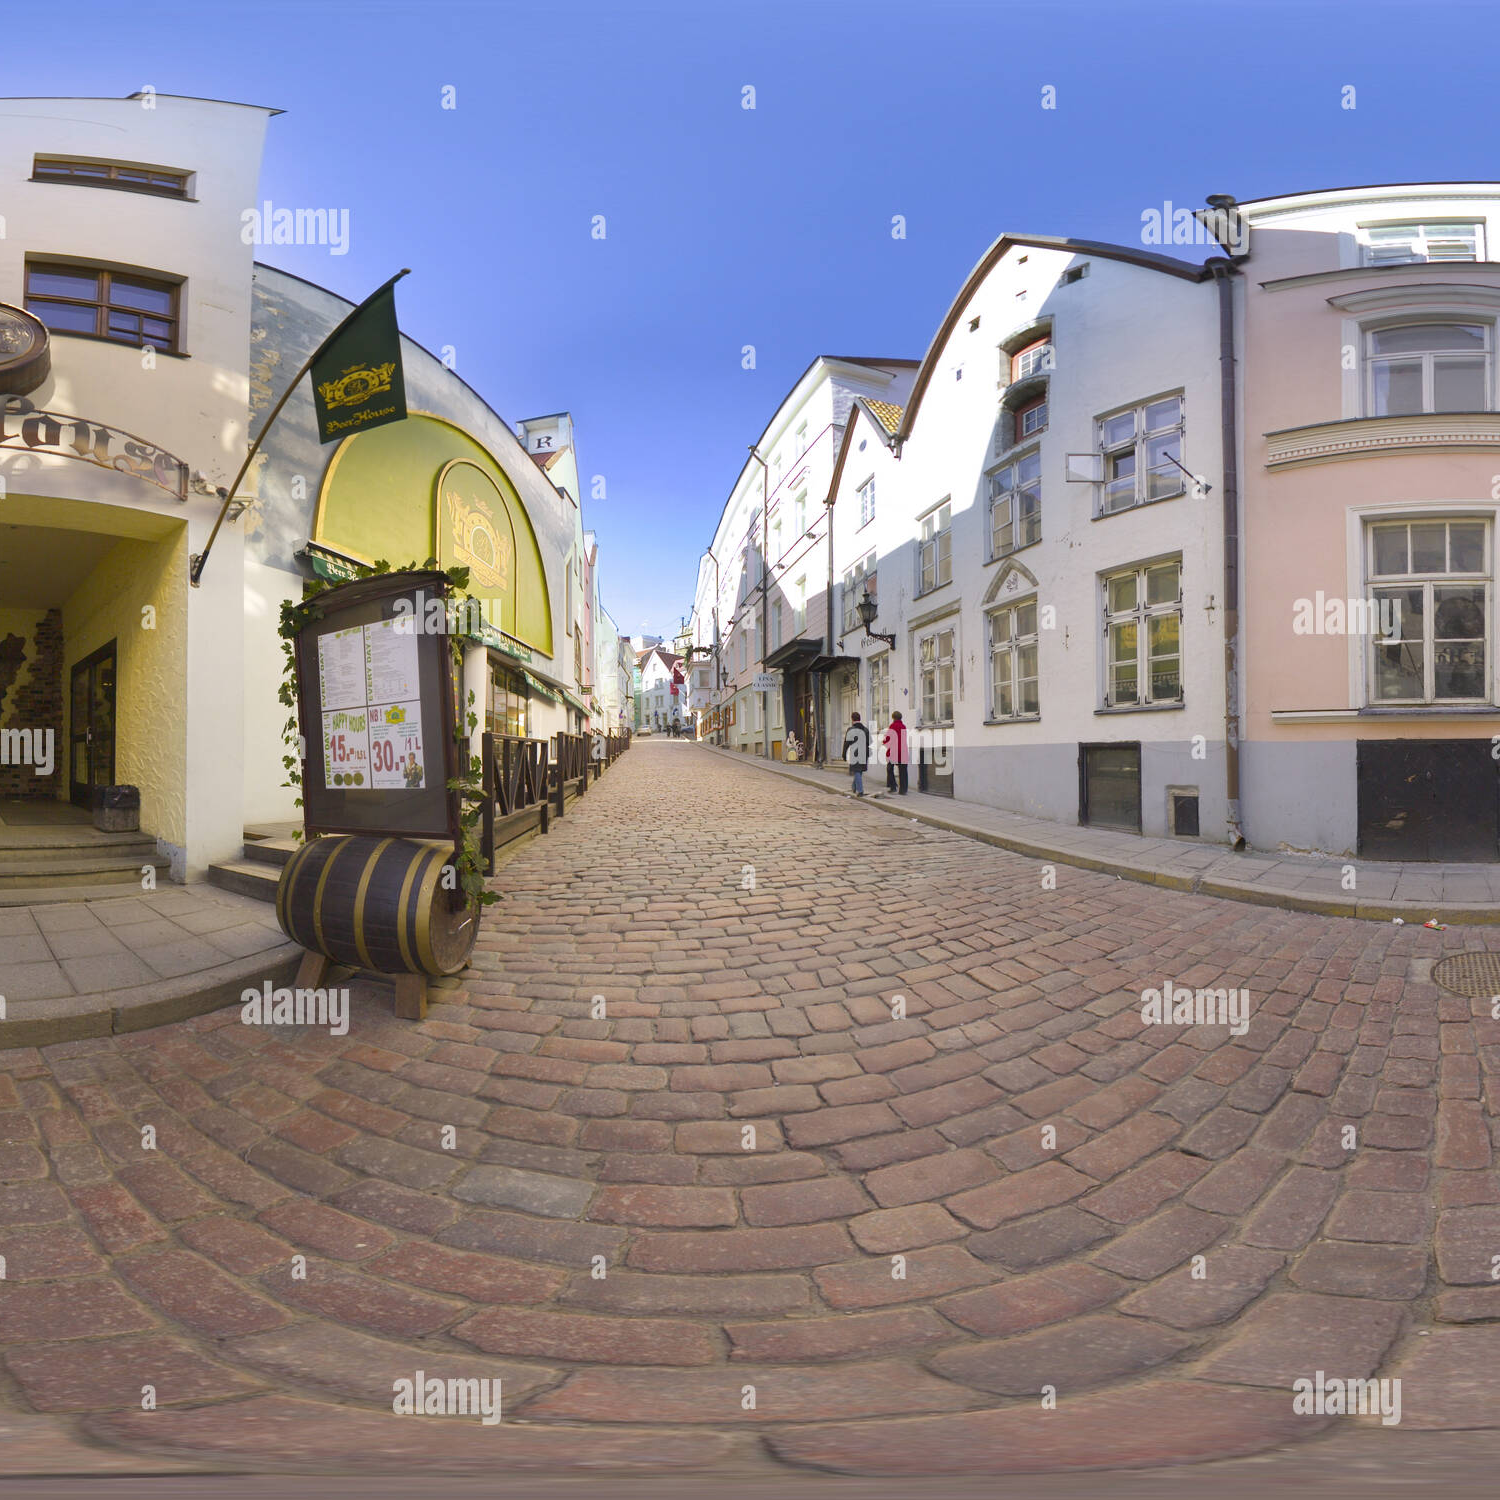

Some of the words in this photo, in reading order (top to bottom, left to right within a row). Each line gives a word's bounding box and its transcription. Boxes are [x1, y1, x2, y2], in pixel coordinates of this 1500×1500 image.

[326, 420, 353, 434] Beer
[352, 405, 396, 425] House
[536, 436, 552, 449] R
